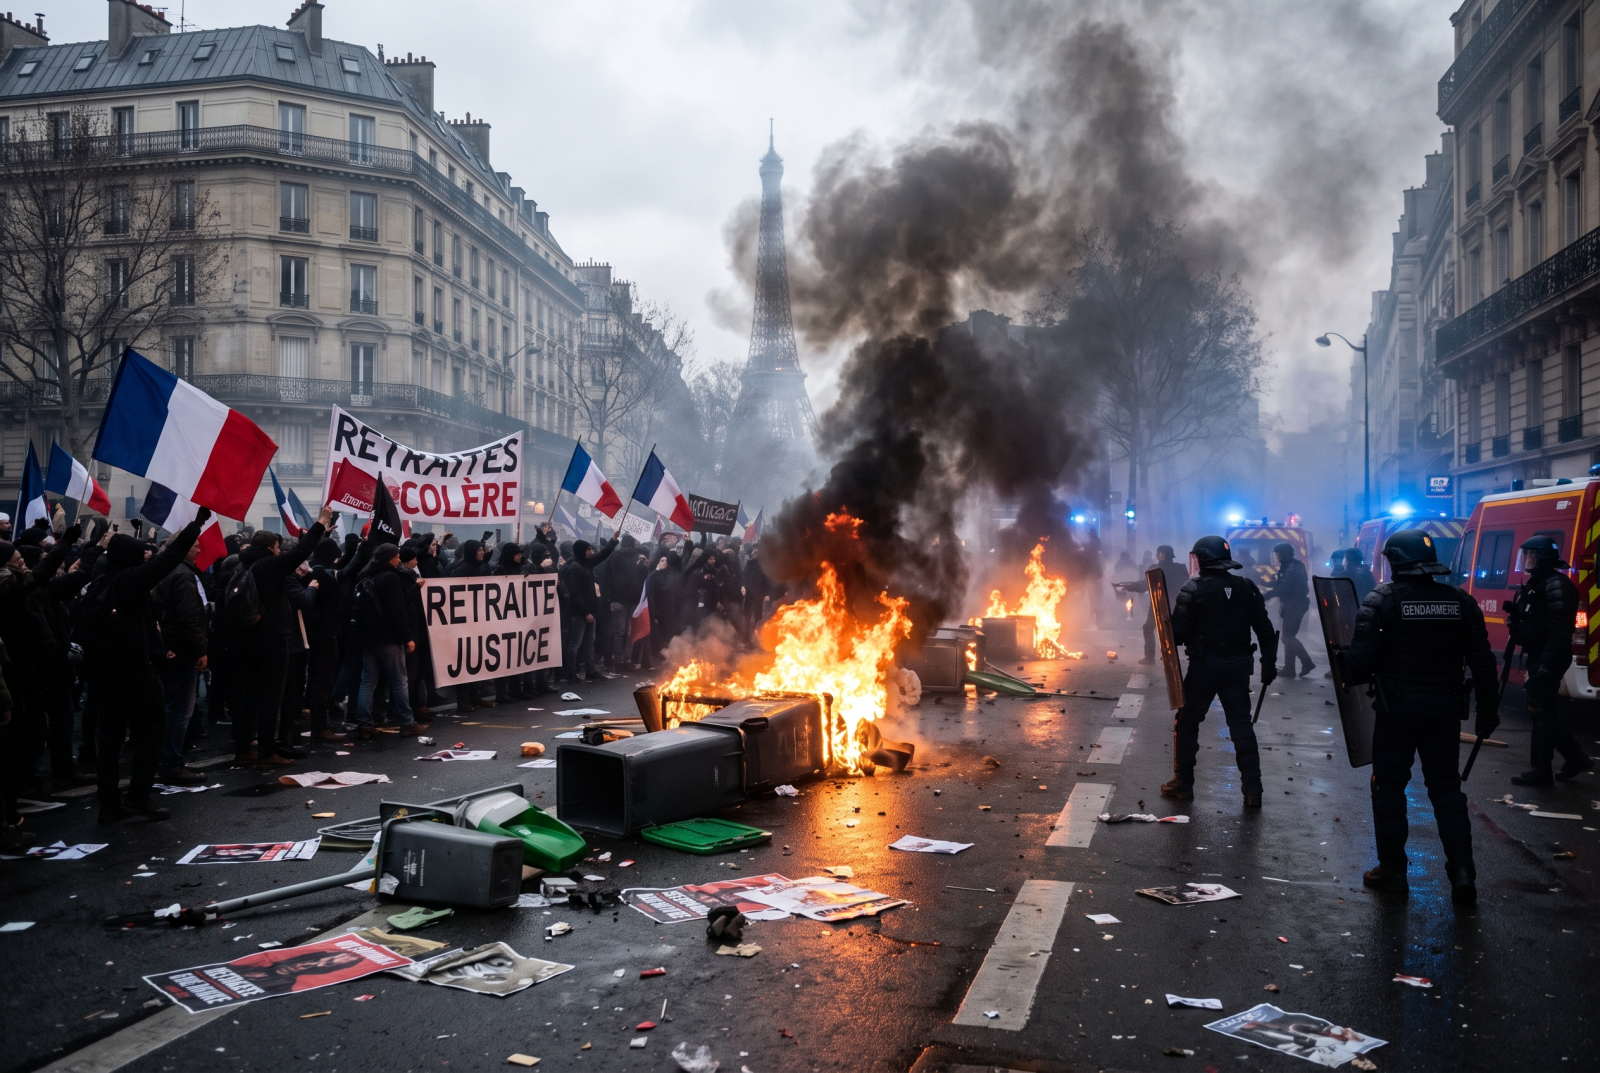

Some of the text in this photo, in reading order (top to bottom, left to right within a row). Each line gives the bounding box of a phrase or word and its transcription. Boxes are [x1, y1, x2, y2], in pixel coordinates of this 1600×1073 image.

[334, 413, 519, 478] RETRAITES
[400, 477, 518, 518] COLÈRE
[427, 579, 556, 626] RETRAITE
[1403, 604, 1460, 616] GENDARMERIE
[447, 627, 550, 679] JUSTICE
